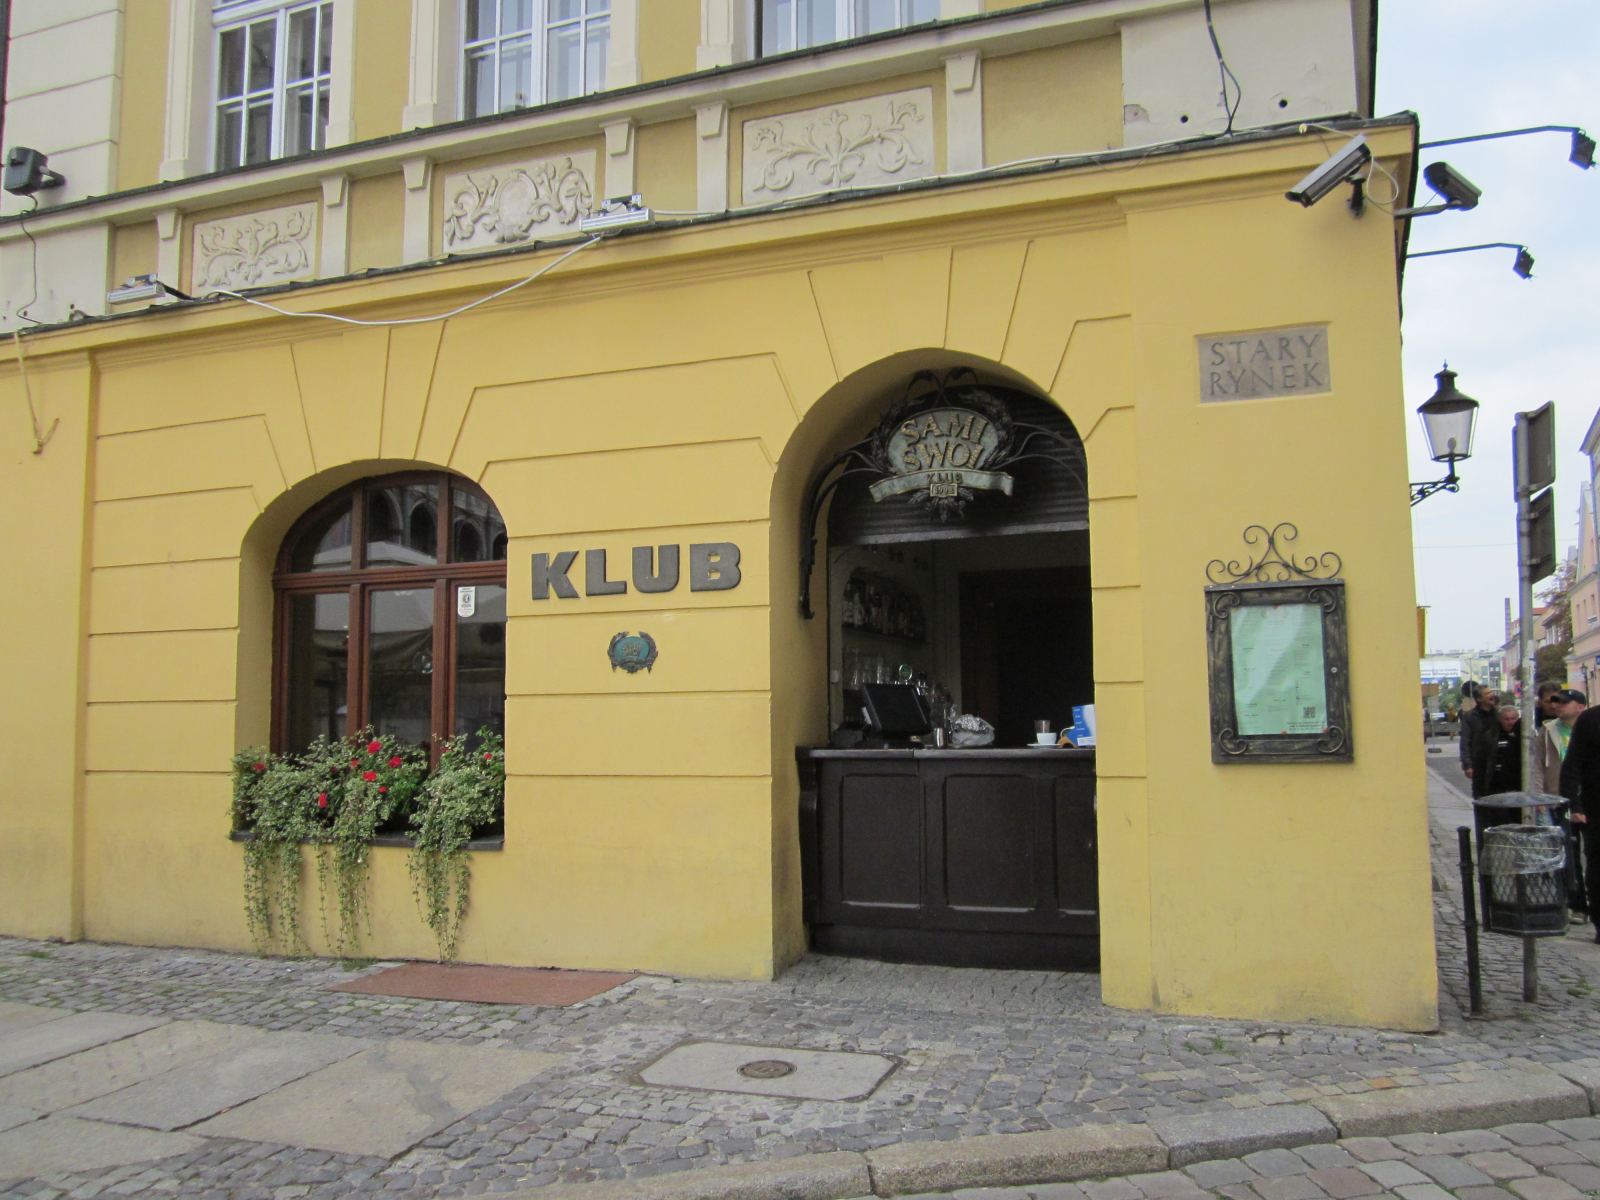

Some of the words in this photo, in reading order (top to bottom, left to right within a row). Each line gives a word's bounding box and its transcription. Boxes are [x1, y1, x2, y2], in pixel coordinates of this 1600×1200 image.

[1210, 334, 1320, 366] STARY
[1209, 362, 1323, 396] RYNEK
[901, 413, 988, 446] SAMI
[902, 440, 985, 472] SWOI
[928, 472, 963, 484] KLUB
[531, 542, 742, 600] KLUB
